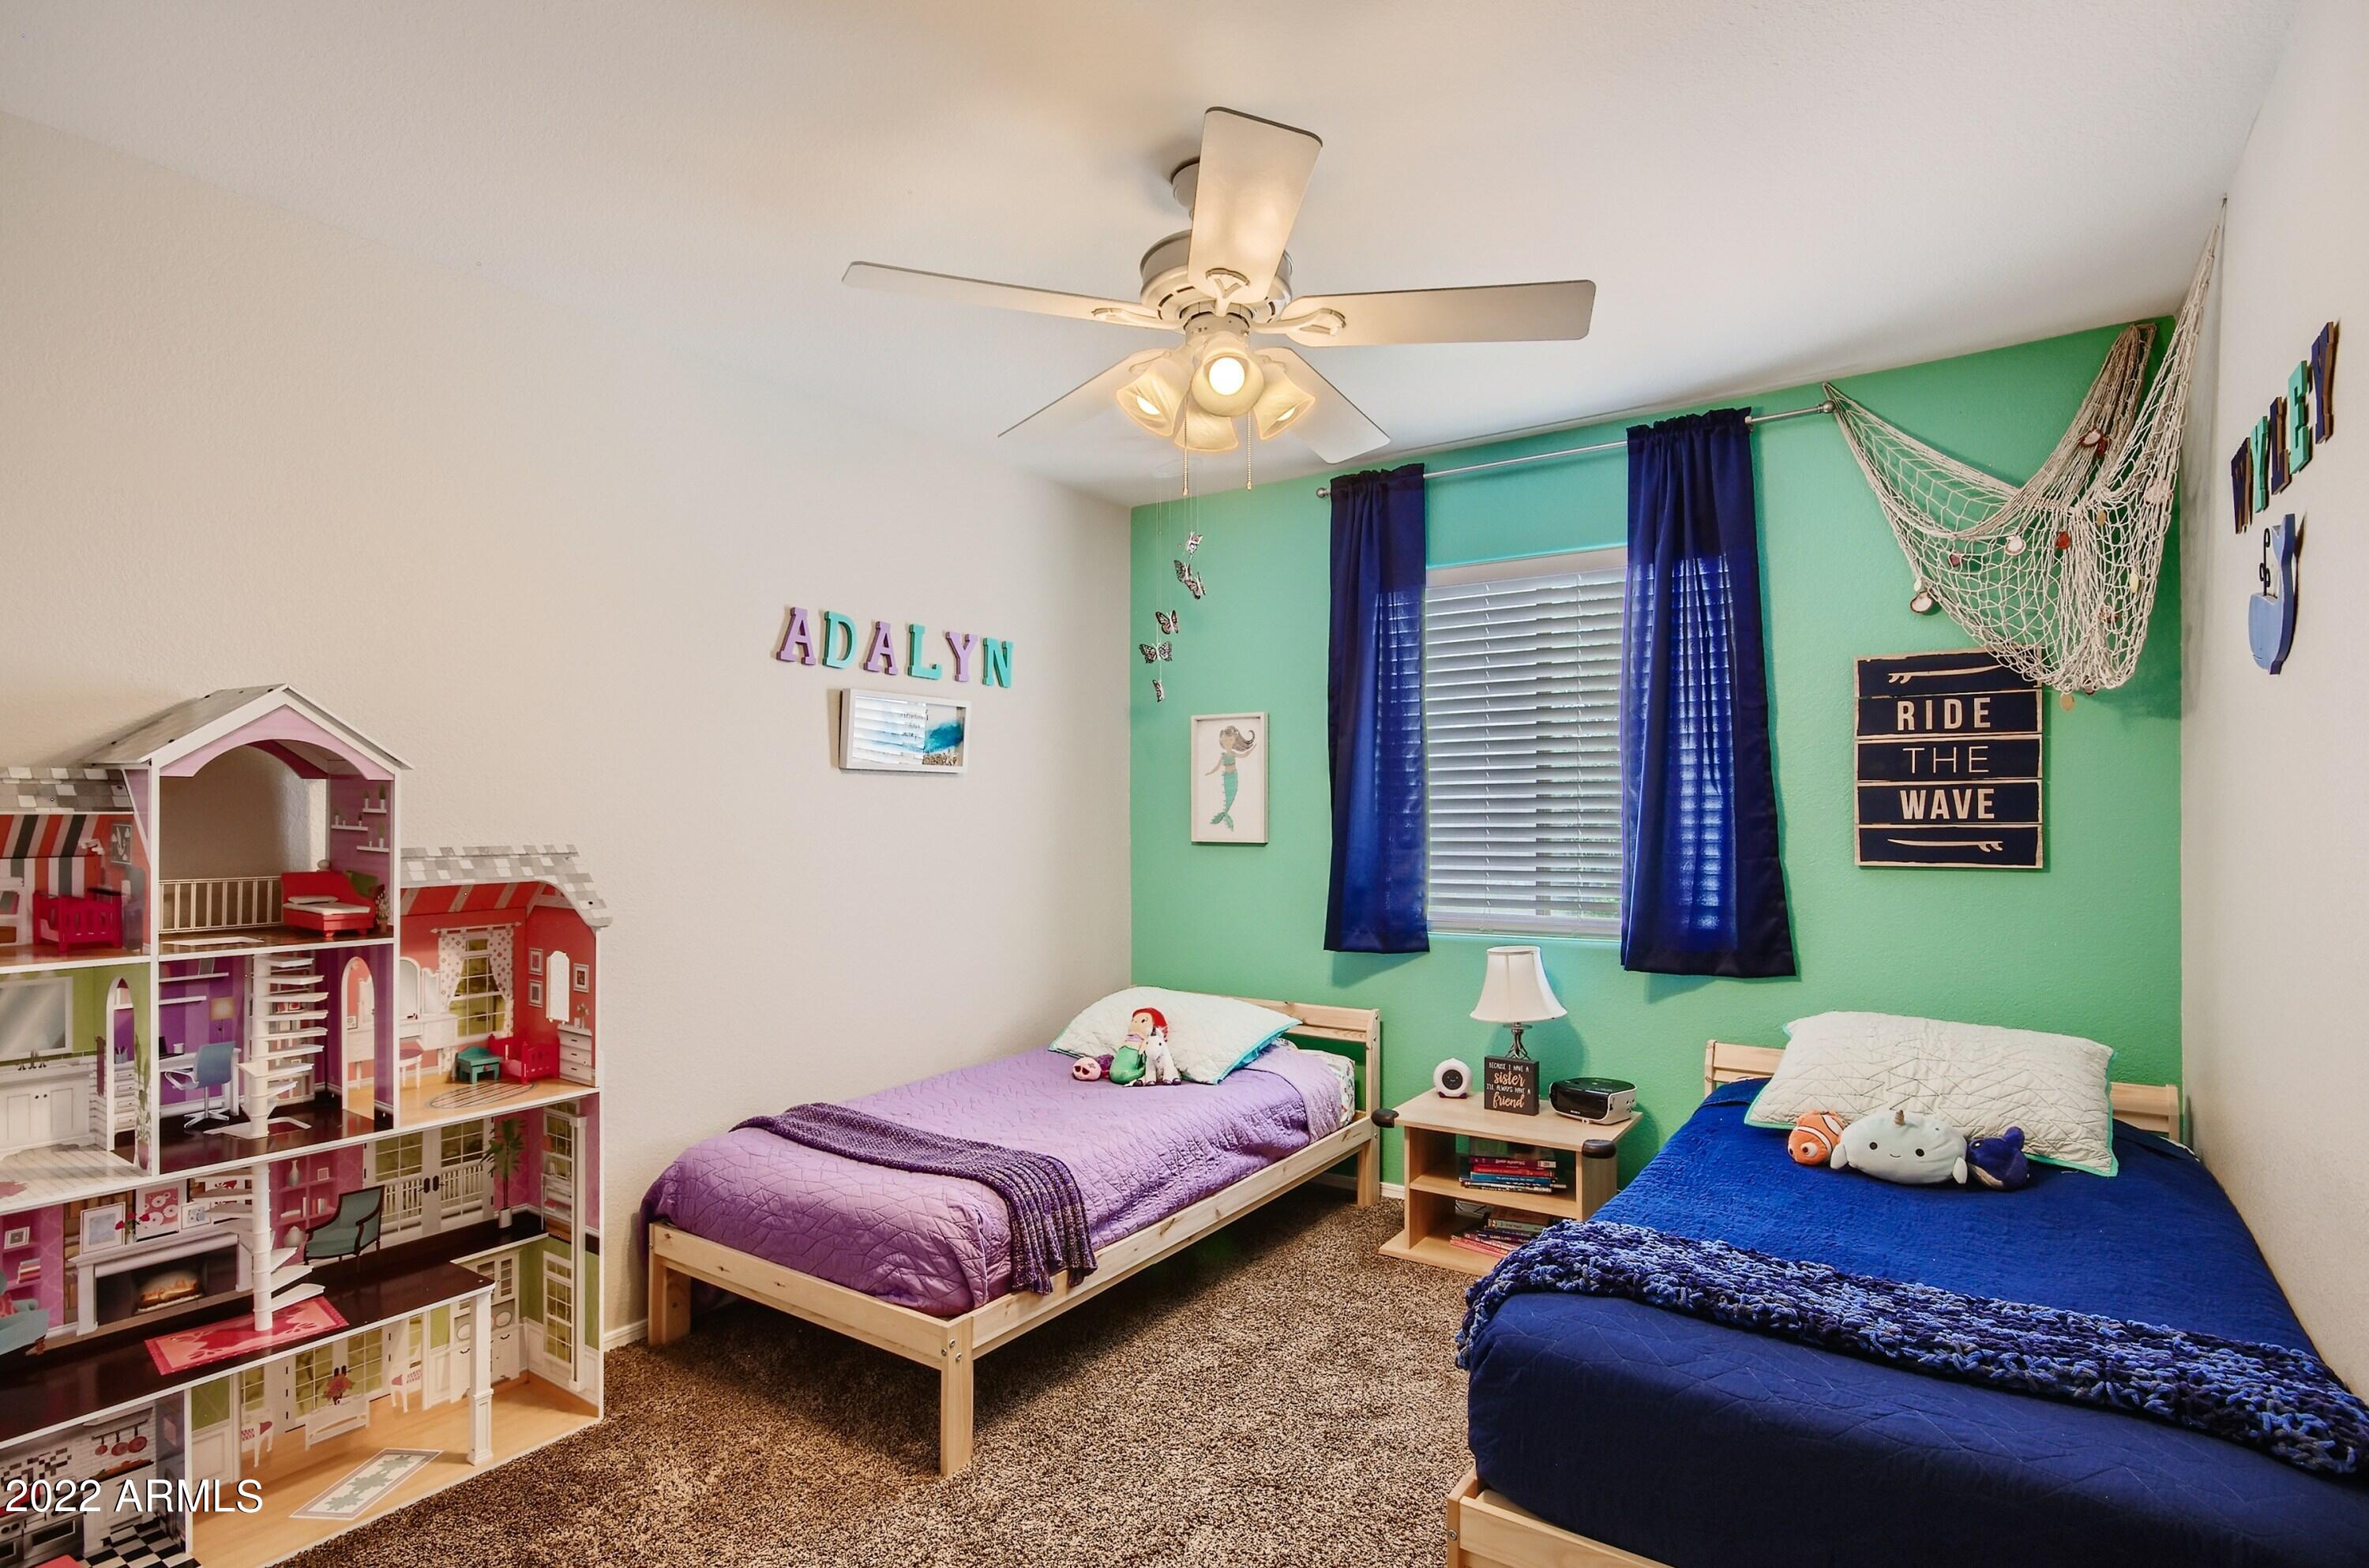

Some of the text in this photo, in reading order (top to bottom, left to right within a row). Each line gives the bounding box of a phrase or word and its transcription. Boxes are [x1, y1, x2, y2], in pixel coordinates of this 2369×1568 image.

[776, 606, 1014, 688] ADALYN
[1897, 697, 1991, 731] RIDE
[1902, 745, 1989, 774] THE
[1899, 788, 1995, 820] WAVE
[1493, 1071, 1526, 1087] sister
[1492, 1091, 1525, 1108] friend
